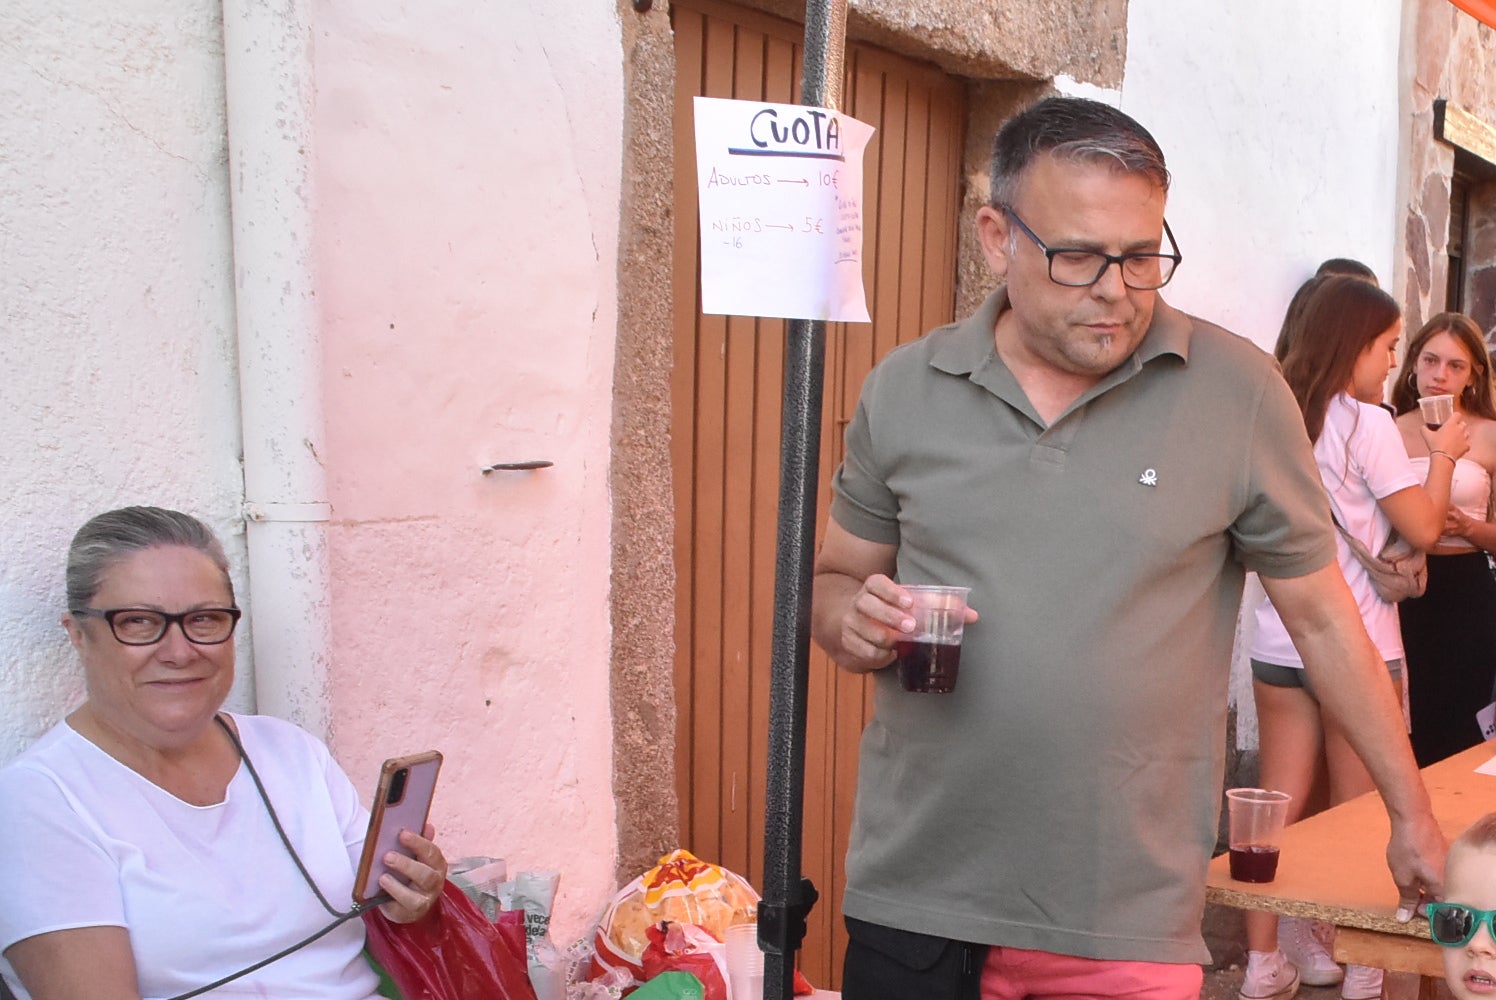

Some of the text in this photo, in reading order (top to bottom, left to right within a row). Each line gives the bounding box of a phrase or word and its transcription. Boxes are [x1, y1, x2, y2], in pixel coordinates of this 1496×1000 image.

[751, 108, 839, 150] CUOTA
[707, 166, 840, 190] ADULTOS 10€
[802, 216, 824, 235] 5€
